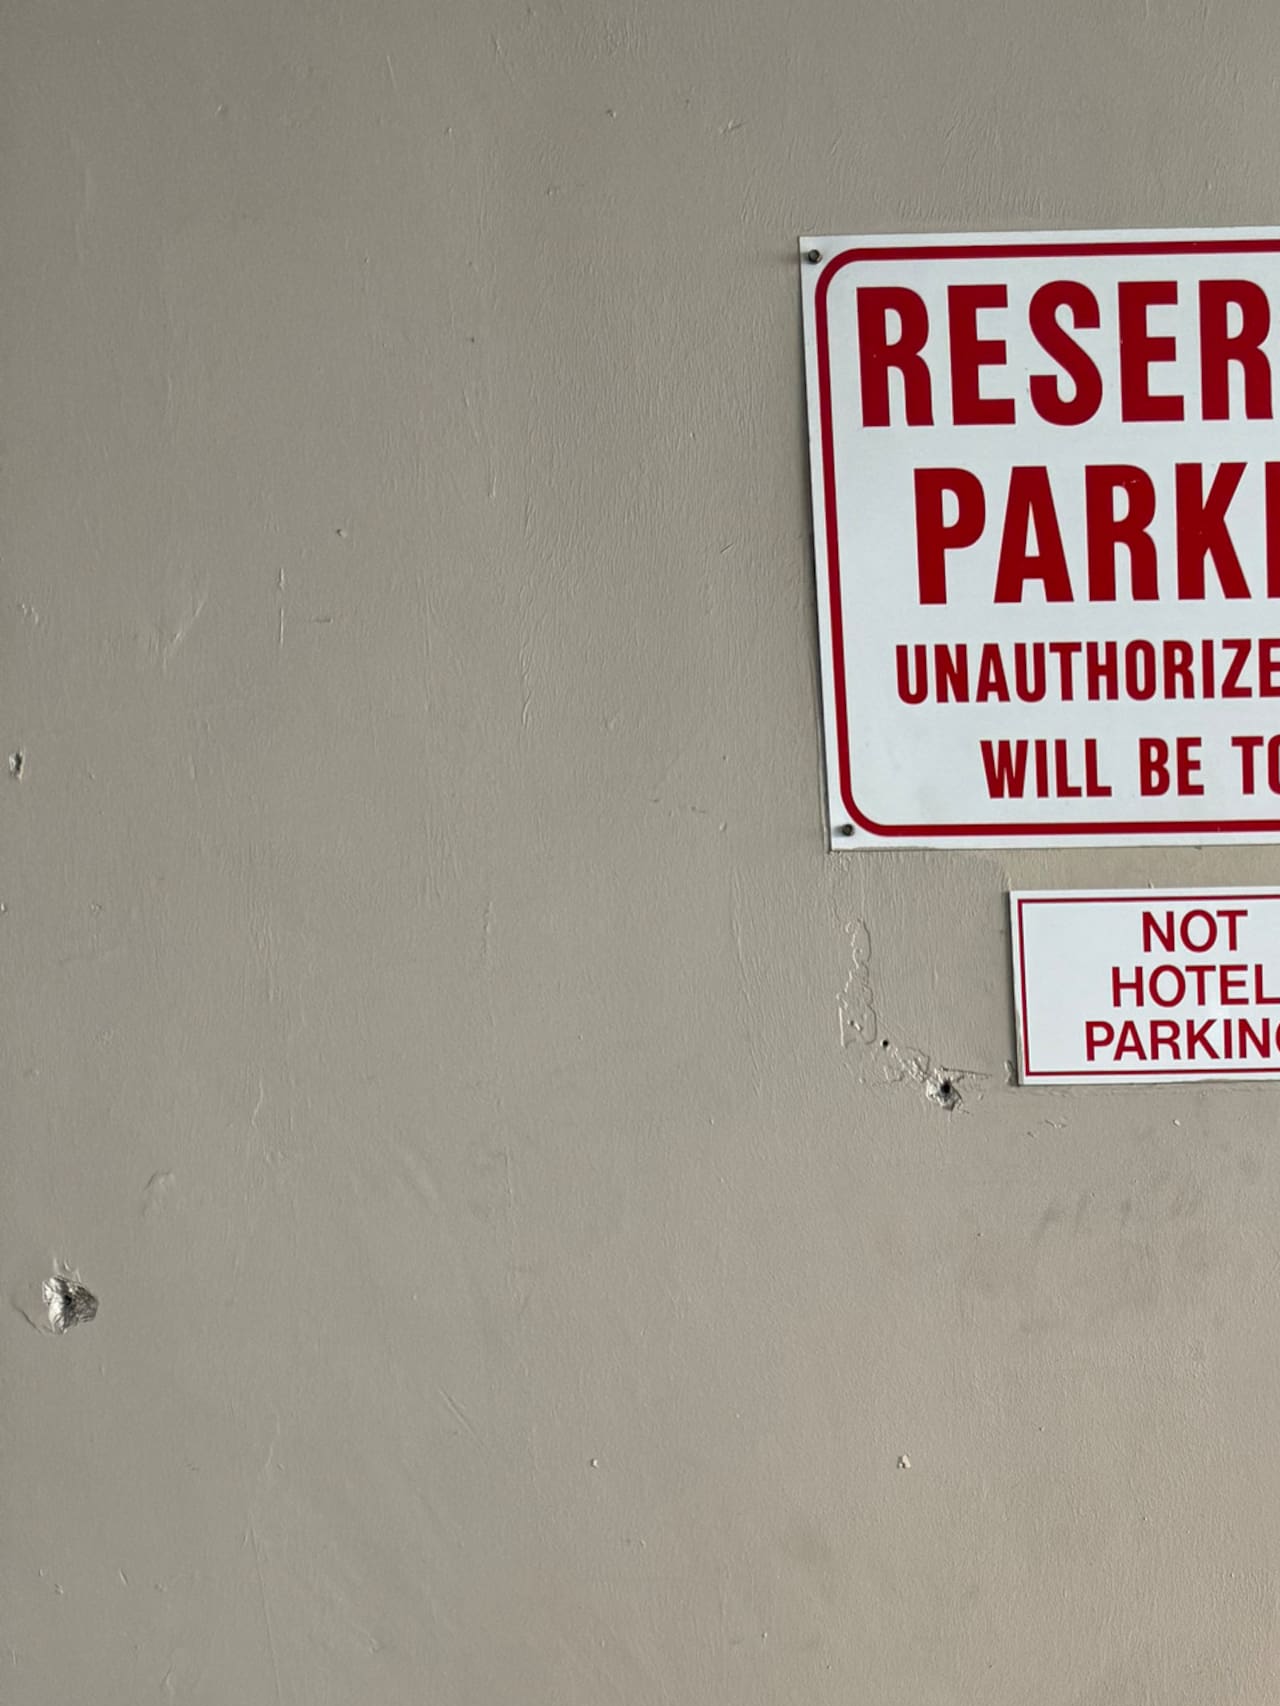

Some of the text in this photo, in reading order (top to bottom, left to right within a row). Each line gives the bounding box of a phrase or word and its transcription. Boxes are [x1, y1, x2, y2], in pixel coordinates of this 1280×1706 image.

[981, 740, 1111, 797] WILL
[1140, 738, 1203, 795] BE
[1143, 910, 1247, 952] NOT
[1113, 965, 1280, 1007] HOTEL
